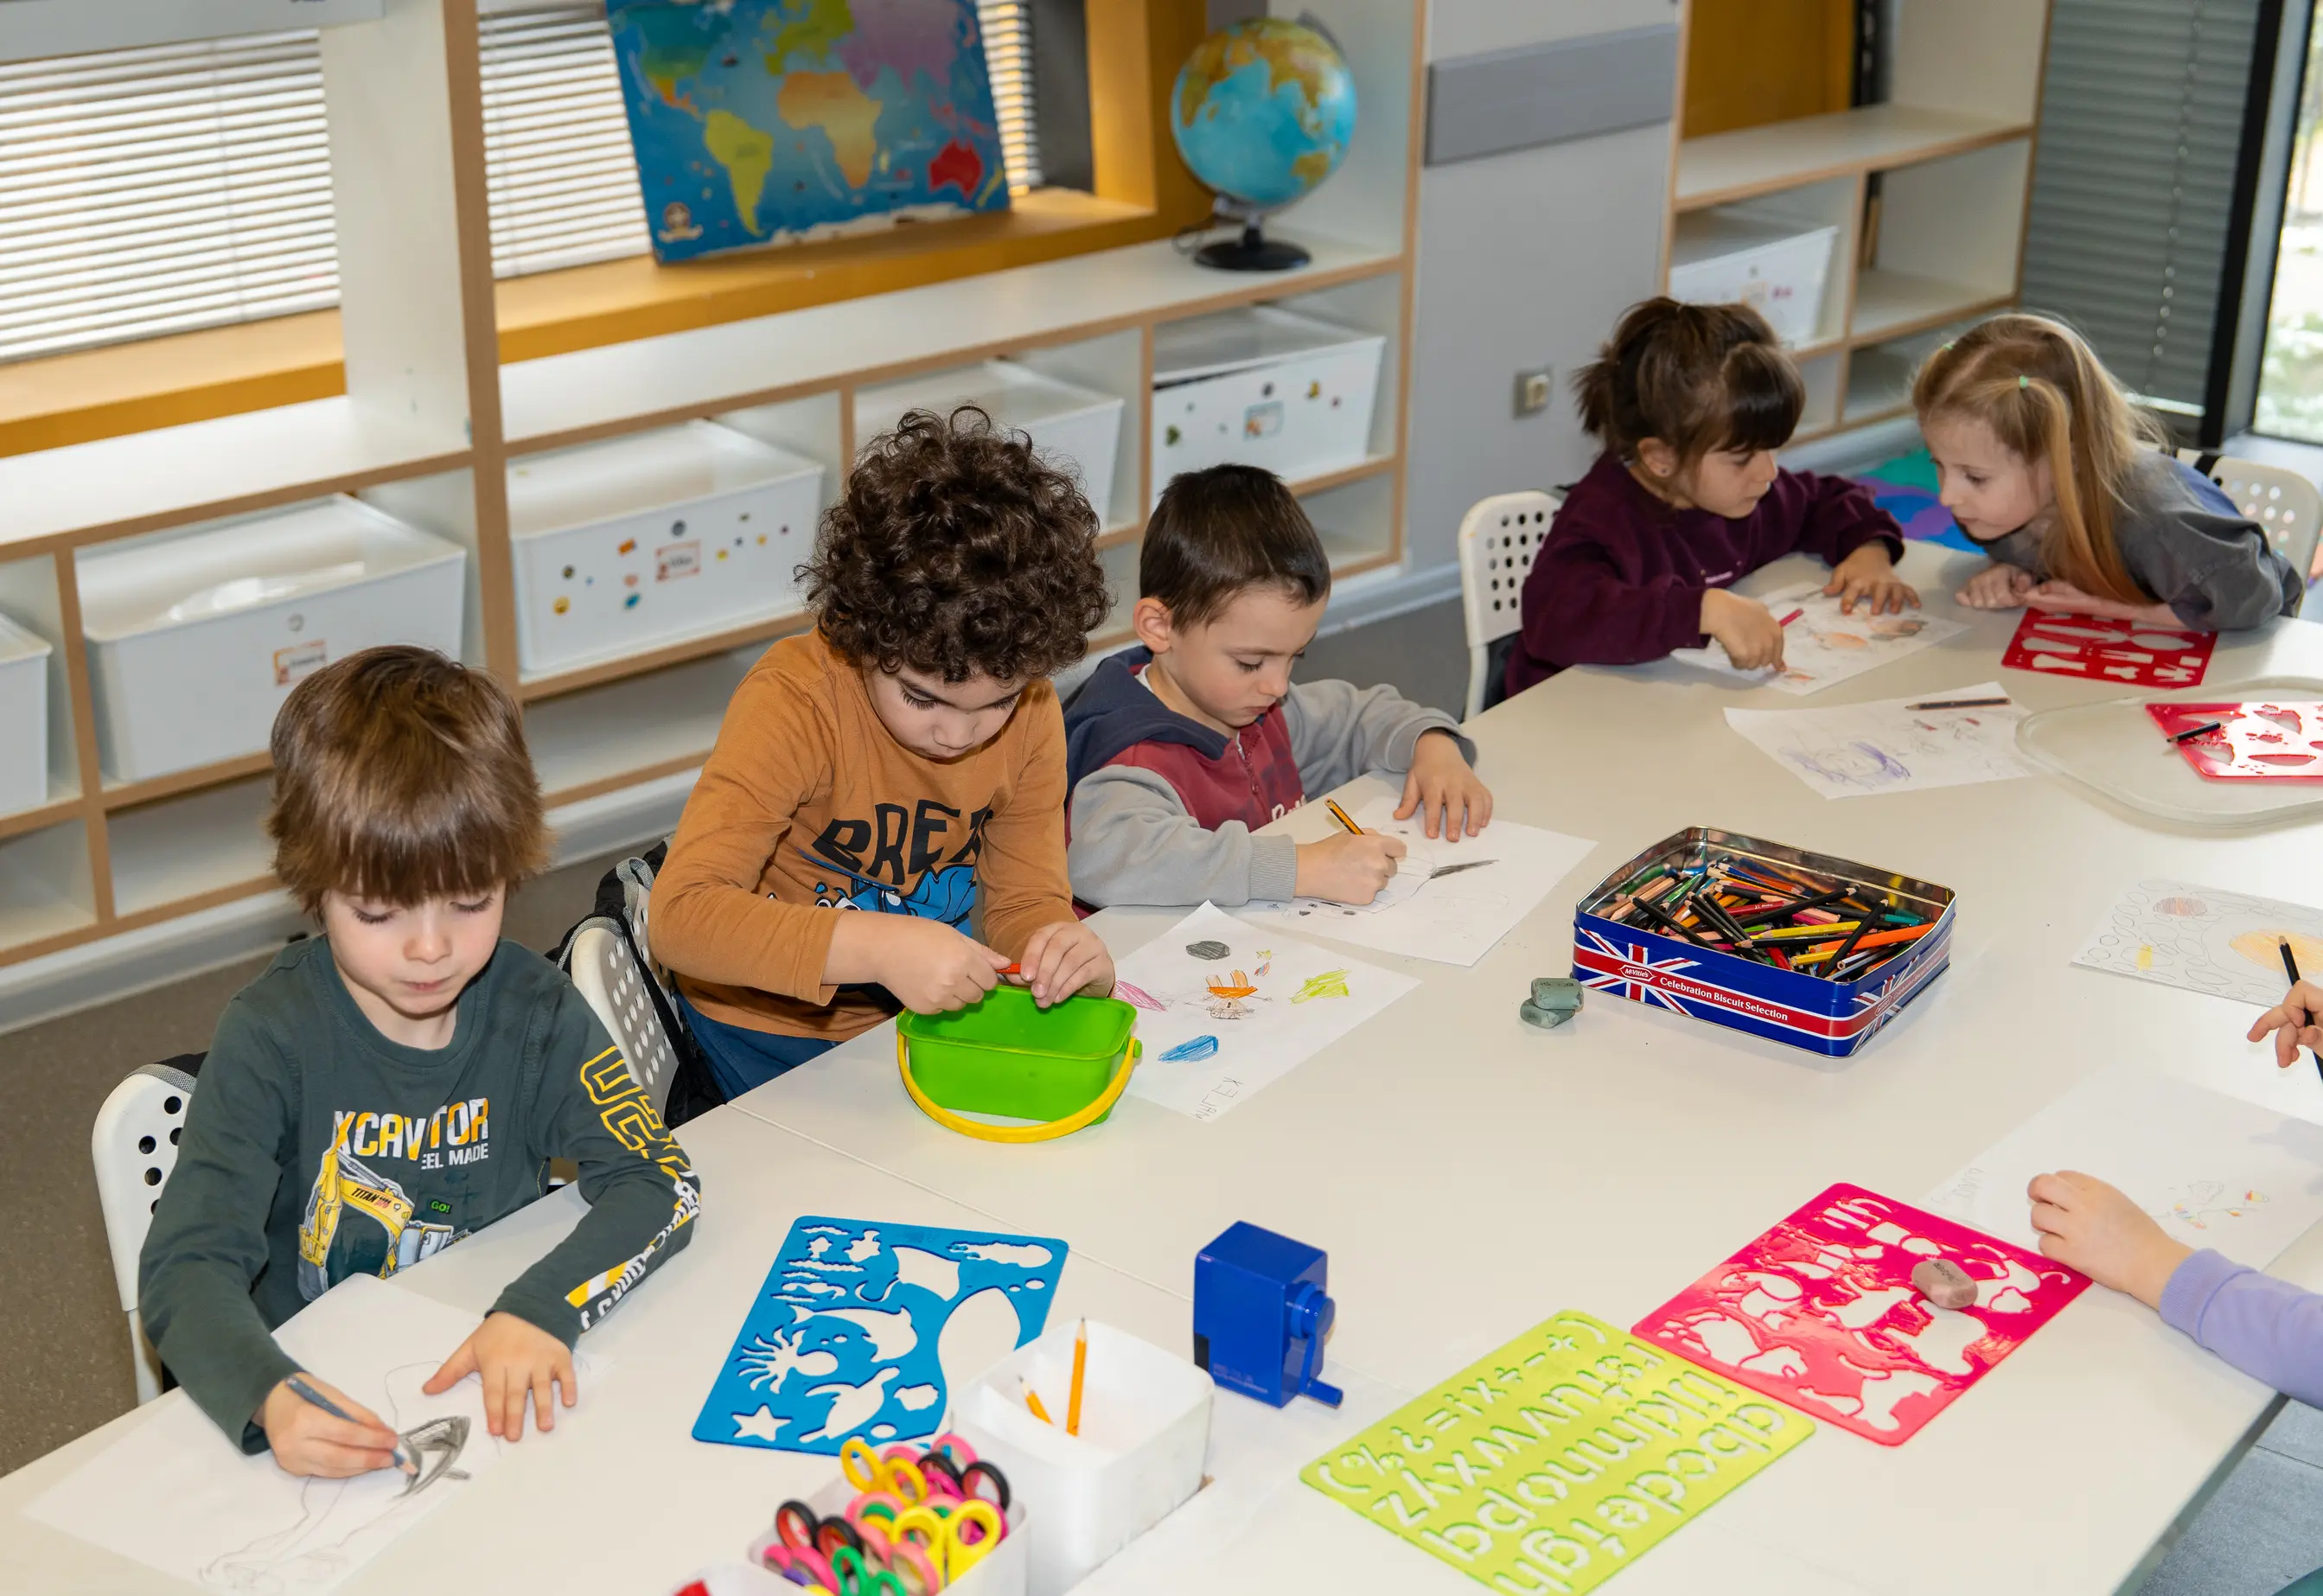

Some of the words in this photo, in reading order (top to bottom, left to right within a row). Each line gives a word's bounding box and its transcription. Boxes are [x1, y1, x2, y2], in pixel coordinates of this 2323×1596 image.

[1659, 977, 1713, 999] Celebration
[1714, 992, 1745, 1009] Biscuit
[1745, 1001, 1789, 1022] Selection
[448, 1142, 489, 1165] MADE
[351, 1187, 379, 1203] TITAN
[431, 1200, 451, 1213] GO!
